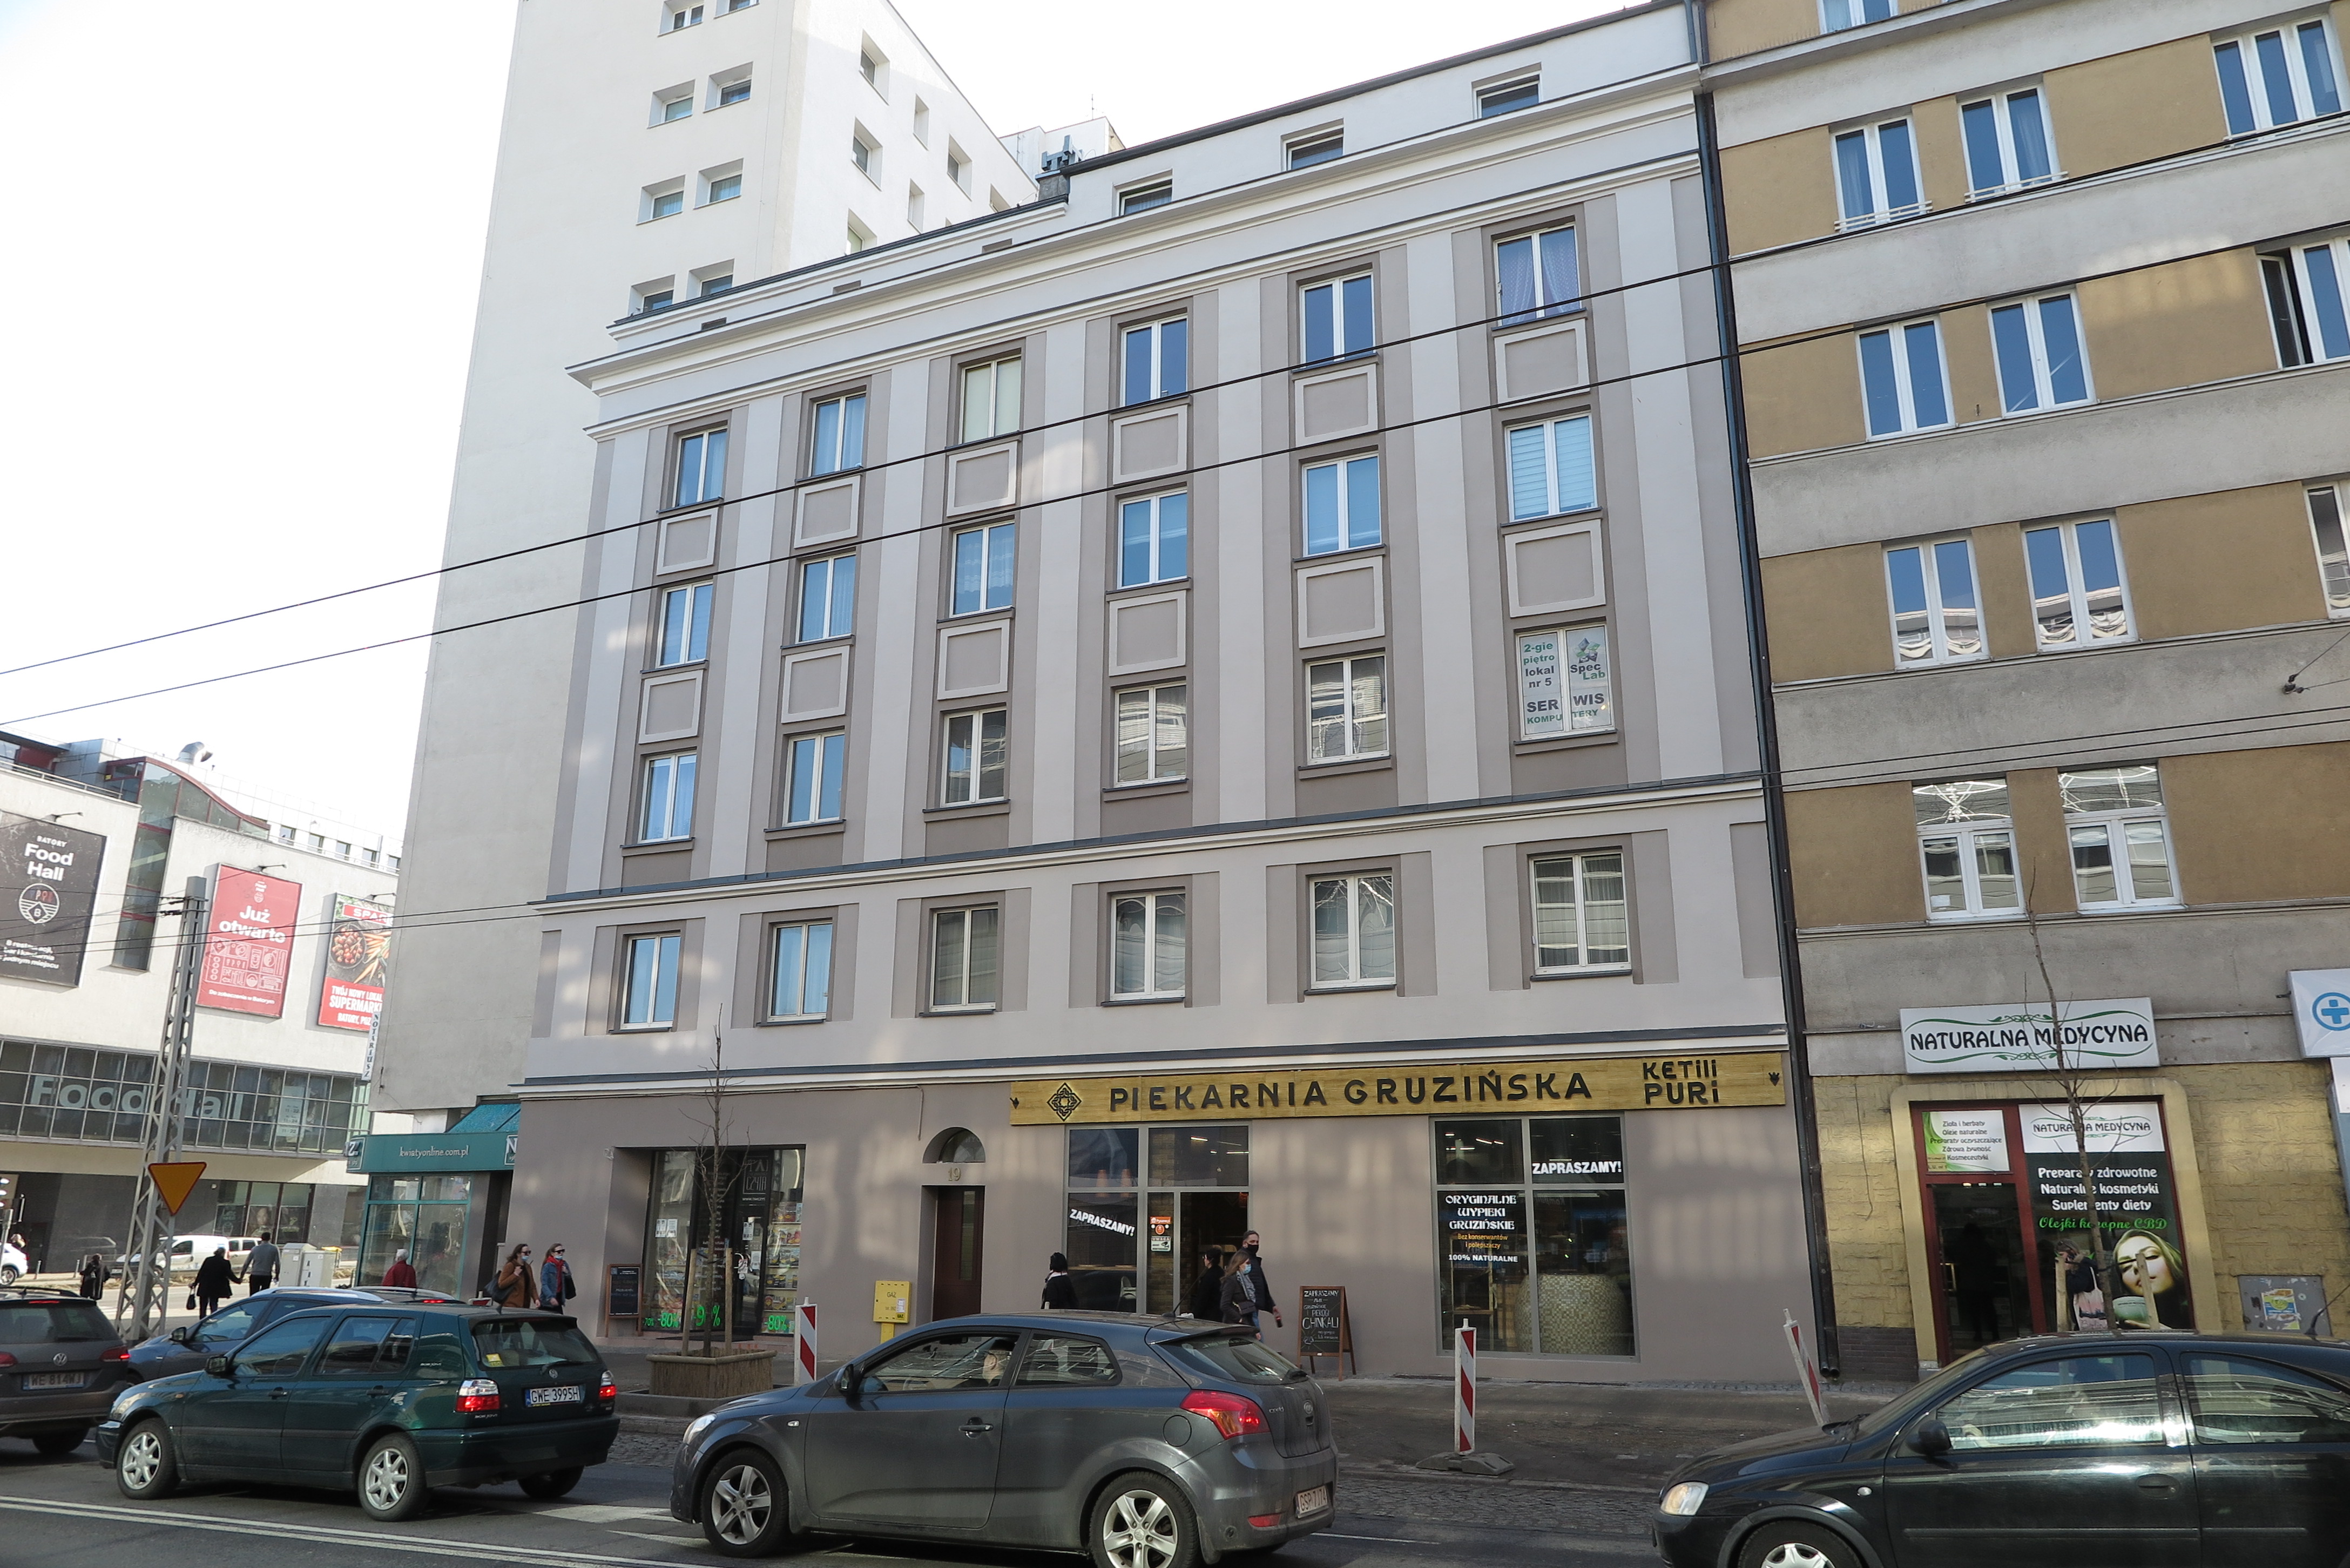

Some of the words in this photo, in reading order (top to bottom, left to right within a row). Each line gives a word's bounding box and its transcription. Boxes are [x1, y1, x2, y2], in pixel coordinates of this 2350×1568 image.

[1524, 642, 1554, 653] 2-gie
[1523, 654, 1555, 665] piętro
[1525, 665, 1555, 677] lokal
[1570, 664, 1601, 674] Spec
[1583, 671, 1605, 680] Lab
[1529, 680, 1541, 688] nr
[1545, 677, 1552, 686] 5
[1527, 699, 1559, 713] SER
[1573, 693, 1604, 706] WIS
[37, 835, 67, 848] BATORY
[24, 842, 75, 866] Food
[27, 861, 64, 881] Hall
[239, 905, 271, 923] Już
[353, 907, 388, 923] SPAR
[219, 920, 286, 943] otwarte
[332, 984, 348, 996] TWÓJ
[348, 988, 367, 999] NOWY
[1910, 1029, 2029, 1051] NATURALNA
[2035, 1024, 2149, 1046] MEDYCYNA
[31, 1075, 148, 1113] Food
[1110, 1080, 1327, 1112] PIEKARNIA
[1344, 1069, 1592, 1105] GRUZIŃSKA
[2095, 1122, 2151, 1132] MEDYCYNA
[399, 1145, 469, 1159] kwiatyonline.com.pl
[948, 1167, 961, 1181] 19
[1532, 1161, 1622, 1174] ZAPRASZAMY!
[2097, 1166, 2158, 1178] zdrowotne
[2099, 1183, 2159, 1194] kosmetyki
[1445, 1195, 1517, 1205] ORYGINALNE
[2123, 1199, 2152, 1211] diety
[1457, 1208, 1506, 1217] WYPIEKI
[1070, 1208, 1135, 1236] ZAPRASZAMY!
[1449, 1219, 1515, 1230] GRUZIŃSKIE
[2039, 1217, 2077, 1232] Olejki
[2134, 1218, 2167, 1229] CBD
[1472, 1254, 1518, 1262] NATURALNE
[657, 1312, 679, 1328] -80%
[764, 1315, 787, 1331] -80%
[1302, 1317, 1339, 1329] CHINKALI
[531, 1389, 550, 1403] GWE
[552, 1387, 579, 1401] 3995H
[1300, 1492, 1312, 1511] GSP
